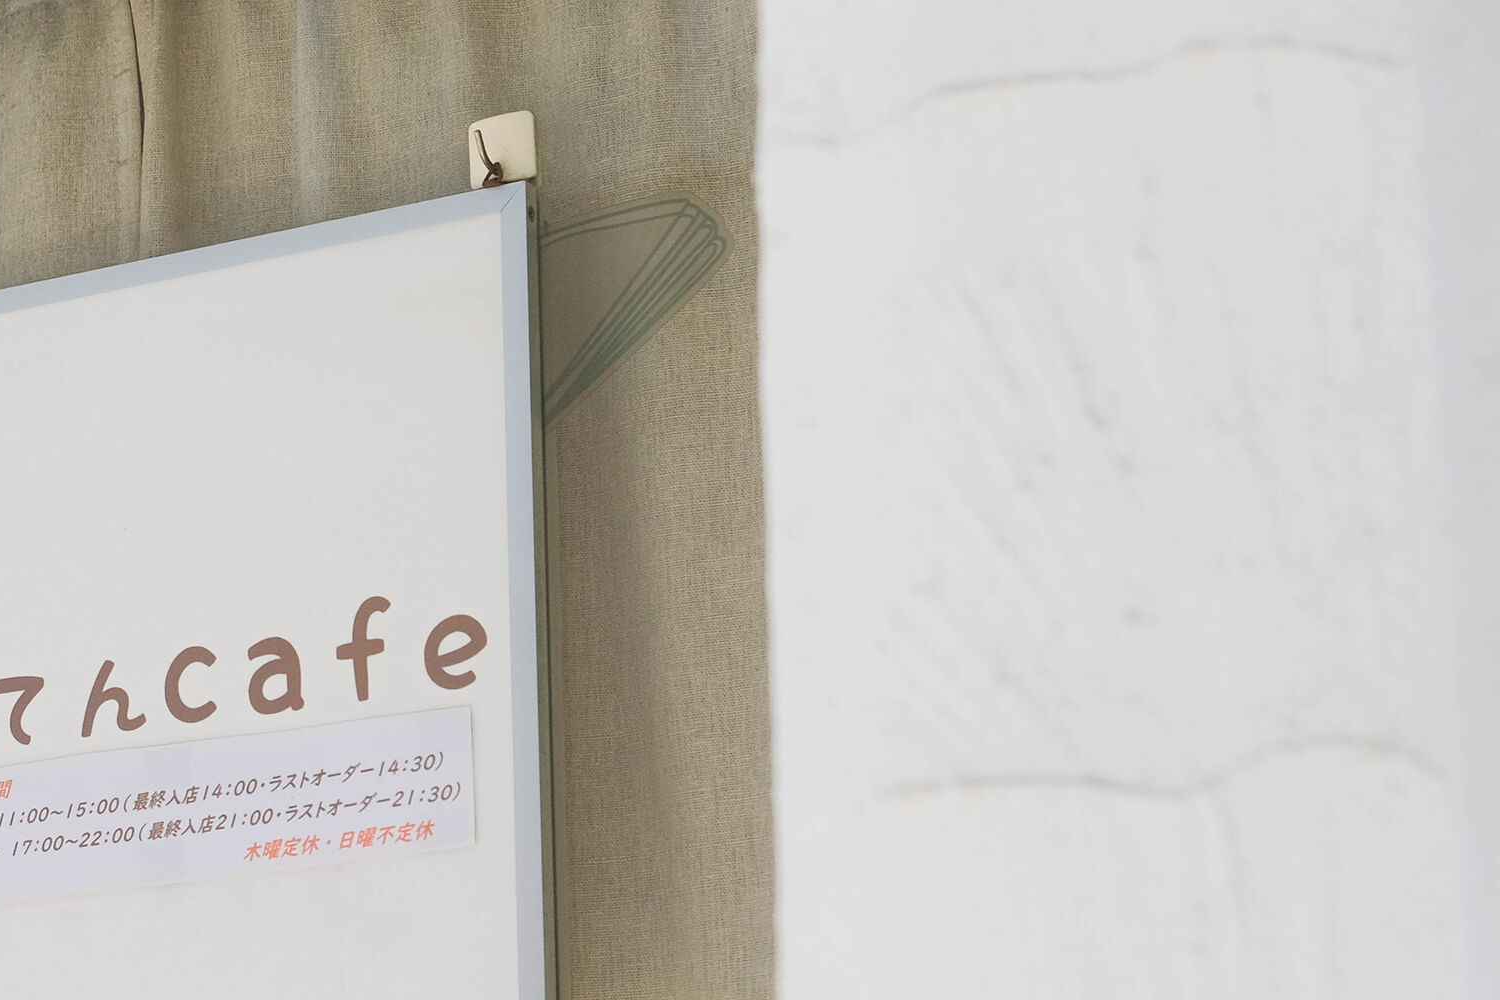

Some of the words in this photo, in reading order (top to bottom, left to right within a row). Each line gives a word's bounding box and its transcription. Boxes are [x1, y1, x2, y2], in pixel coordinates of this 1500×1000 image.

[243, 819, 435, 862] 木曜定休・日曜不定休
